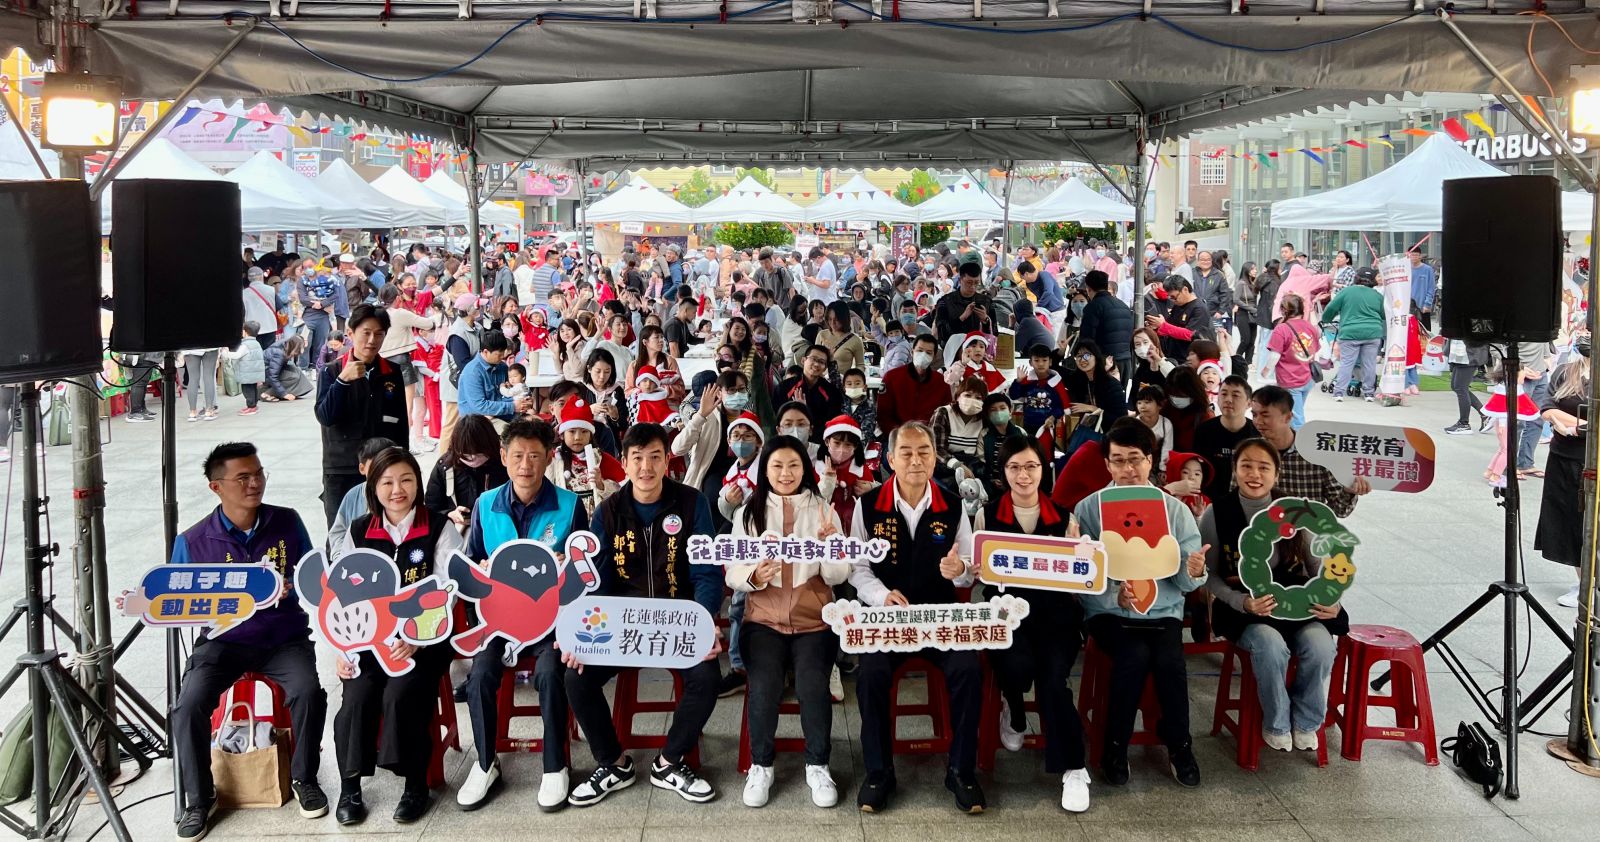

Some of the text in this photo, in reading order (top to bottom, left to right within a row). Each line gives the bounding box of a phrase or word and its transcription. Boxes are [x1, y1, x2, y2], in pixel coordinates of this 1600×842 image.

[1459, 131, 1587, 160] TARBUCS
[1316, 432, 1405, 457] 家庭教育
[1352, 457, 1419, 482] 我最讚
[690, 537, 885, 562] 花蓮縣家庭教育中心
[993, 554, 1090, 575] 我是最棒的
[168, 571, 248, 590] 親子趣
[160, 598, 240, 616] 動出愛
[621, 608, 699, 627] 花蓮縣政府
[861, 607, 992, 624] 2025聖誕親子嘉年華
[574, 645, 611, 655] Hualien
[618, 629, 697, 658] 教育處
